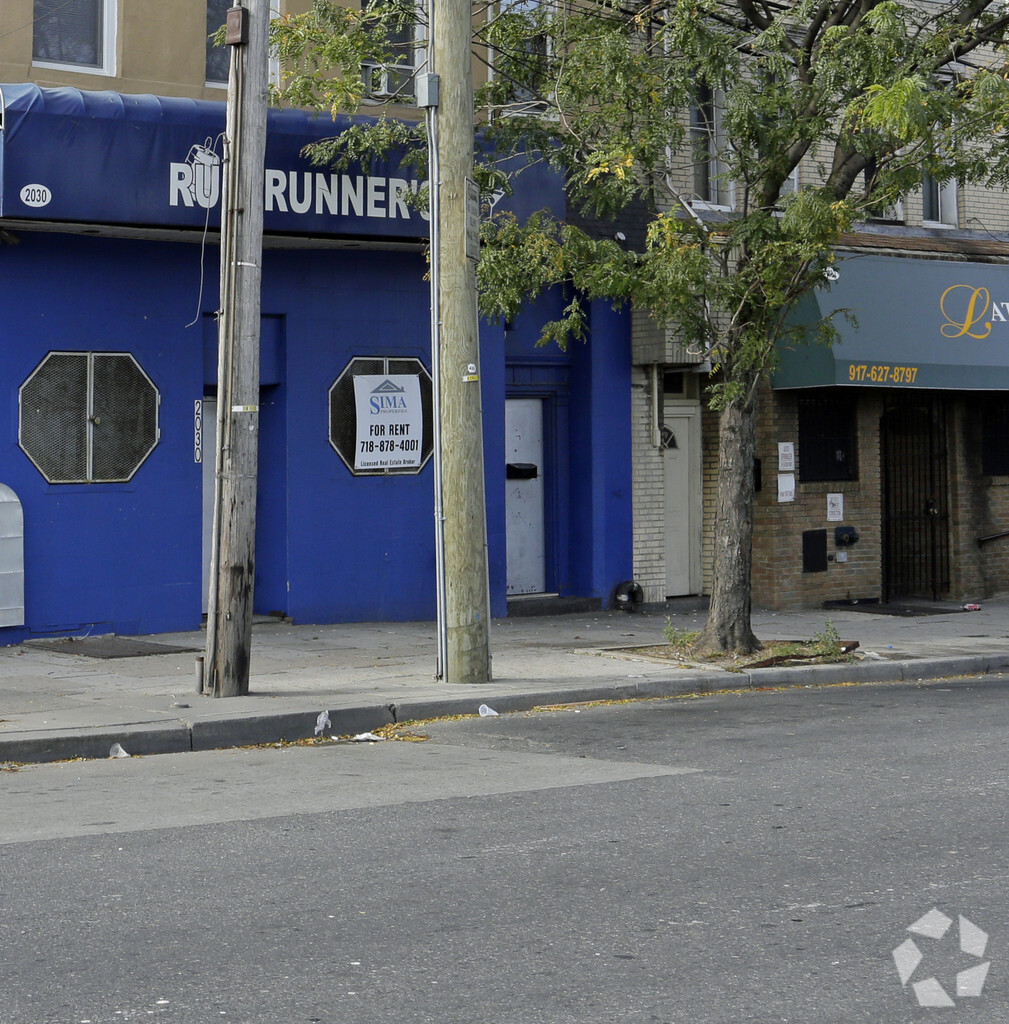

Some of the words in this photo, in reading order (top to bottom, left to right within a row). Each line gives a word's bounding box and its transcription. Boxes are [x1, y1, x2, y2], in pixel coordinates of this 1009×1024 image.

[25, 188, 48, 203] 2030
[169, 162, 221, 209] RU
[848, 364, 918, 384] 917-627-8797
[370, 395, 407, 415] SIMA
[194, 400, 202, 462] 2030
[370, 424, 385, 437] FOR
[389, 424, 410, 436] RENT
[360, 439, 419, 453] 718-878-4001
